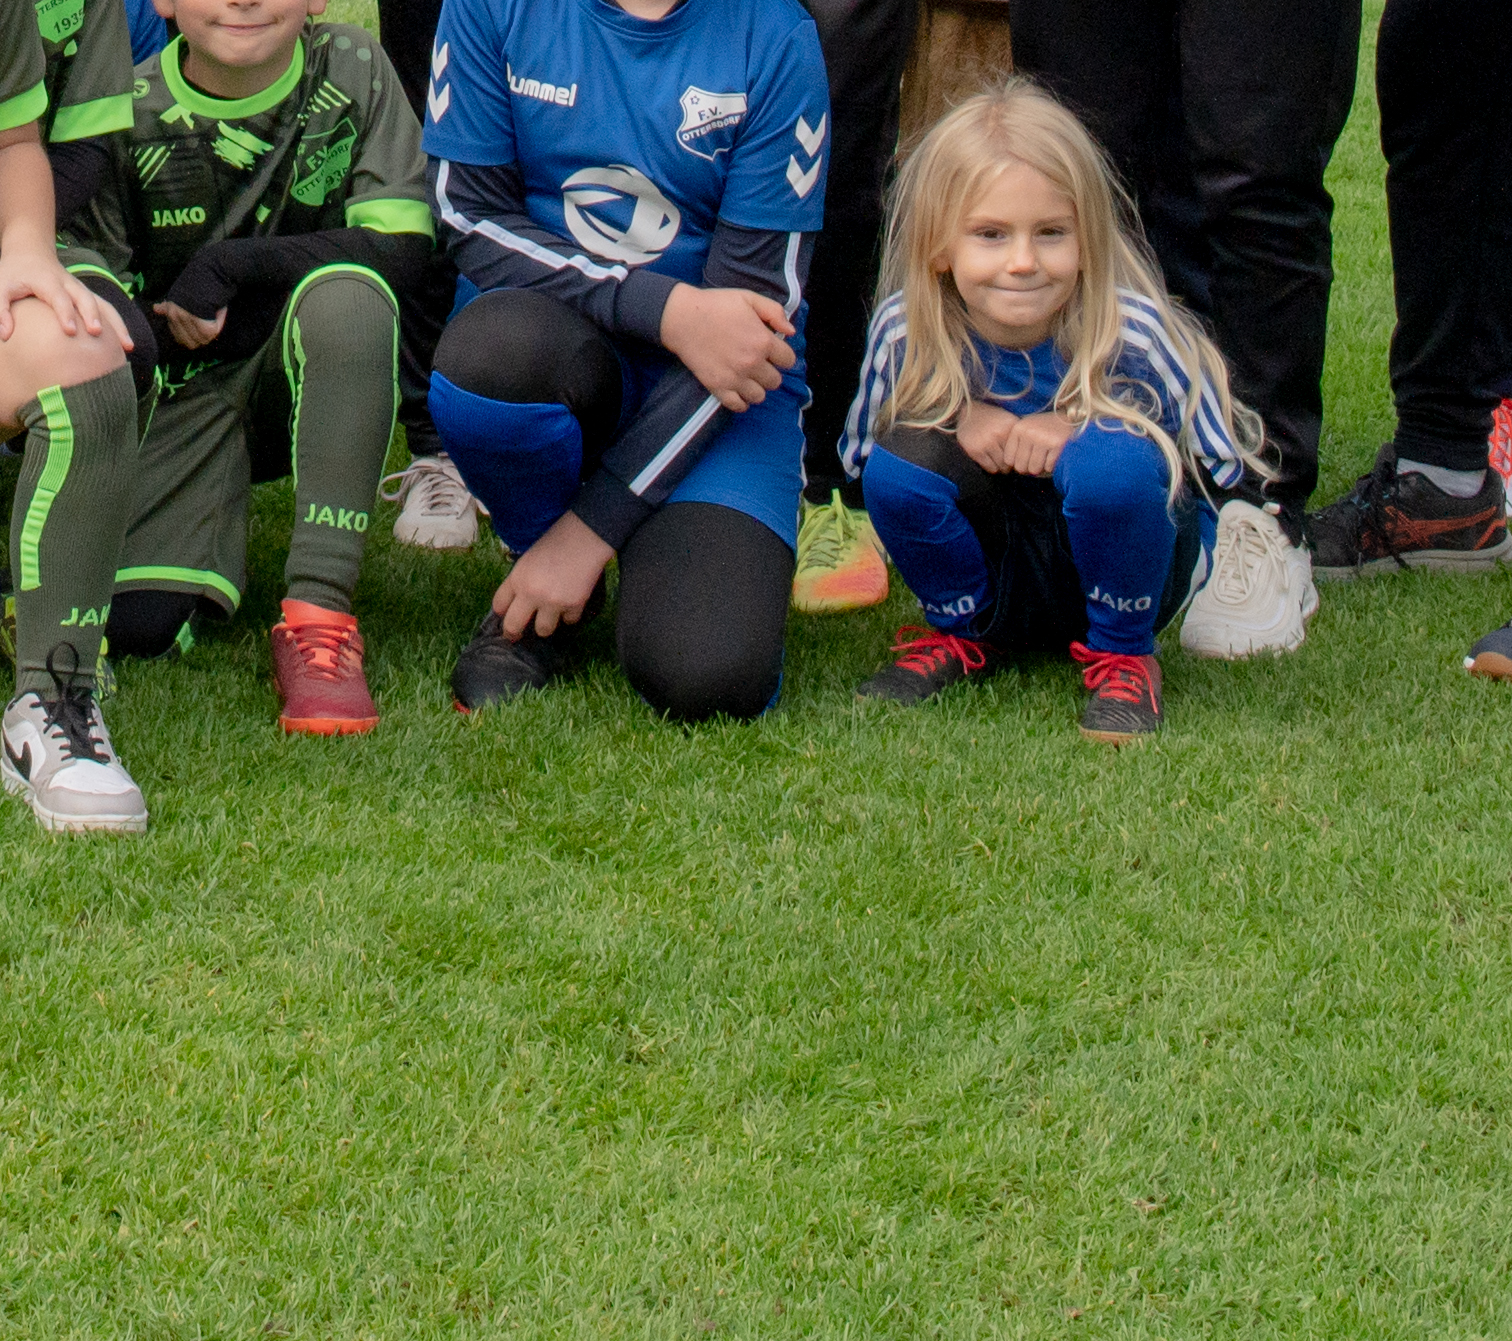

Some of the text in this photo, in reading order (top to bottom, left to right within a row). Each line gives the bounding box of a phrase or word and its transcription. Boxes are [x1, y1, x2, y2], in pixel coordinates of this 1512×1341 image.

[682, 113, 742, 142] OTTERSDORF
[698, 105, 723, 122] F.V.
[152, 205, 206, 228] JAKO
[303, 503, 369, 533] JAKO
[1087, 584, 1152, 612] JAKO
